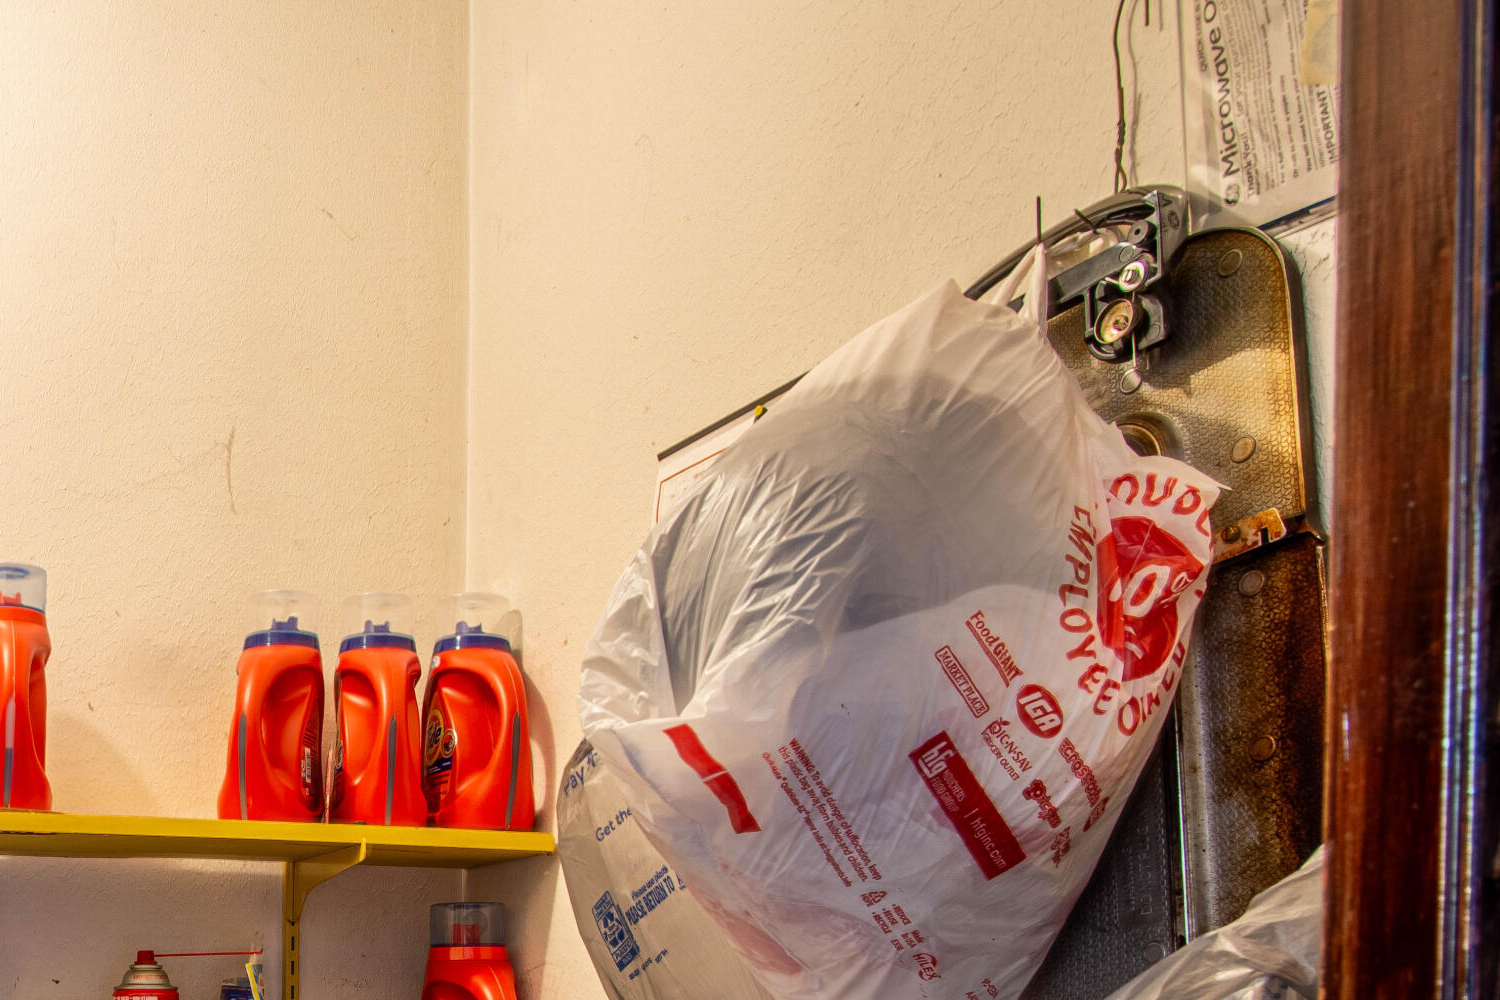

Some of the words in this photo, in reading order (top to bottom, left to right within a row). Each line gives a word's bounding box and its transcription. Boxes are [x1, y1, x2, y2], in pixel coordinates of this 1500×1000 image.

[1209, 27, 1240, 178] Microwave
[1243, 160, 1255, 199] Thank
[969, 609, 1001, 647] Food
[938, 650, 970, 688] MARKET
[962, 685, 986, 715] PLACE
[1018, 689, 1060, 732] IGA
[916, 741, 956, 778] hfg
[999, 758, 1020, 781] OUTLET
[595, 820, 616, 842] Get
[968, 819, 1007, 869] hfginc.com
[624, 899, 648, 926] PLEASE
[642, 881, 668, 913] RETURN
[662, 875, 676, 895] TO
[912, 952, 939, 981] HILEX
